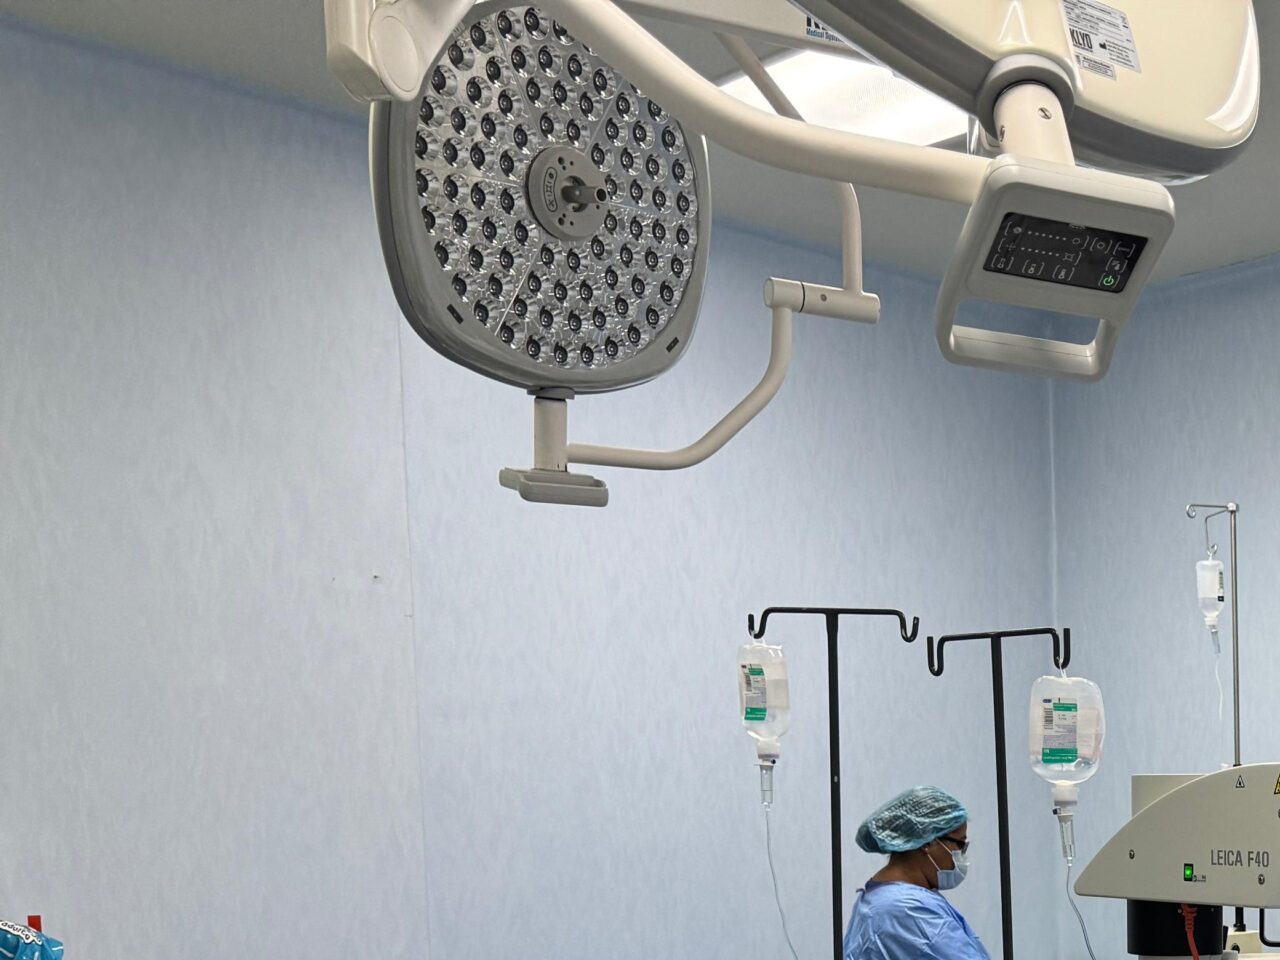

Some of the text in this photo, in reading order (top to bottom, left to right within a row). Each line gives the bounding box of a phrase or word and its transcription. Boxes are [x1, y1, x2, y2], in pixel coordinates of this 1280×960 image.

[806, 28, 825, 38] Medical
[1210, 849, 1270, 868] LEICA F40
